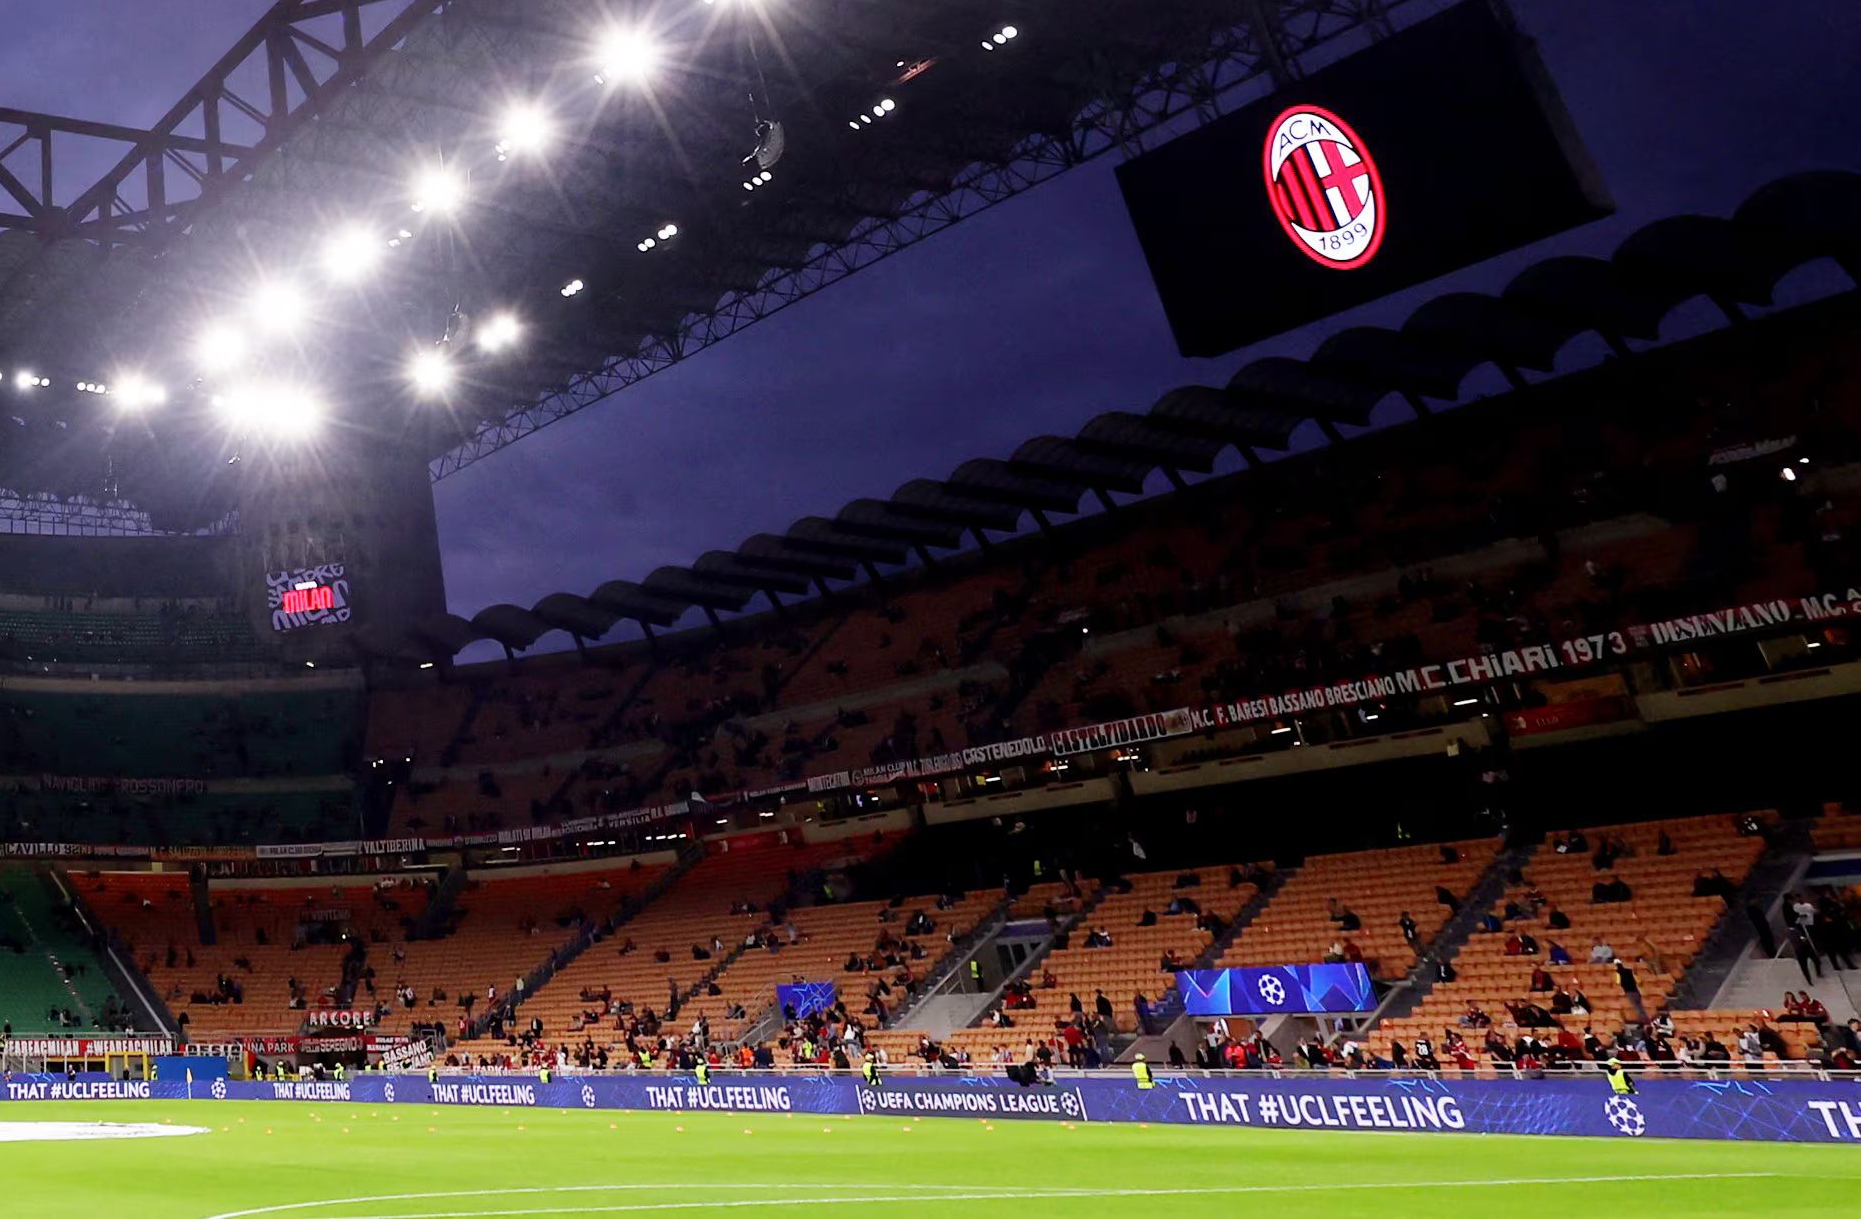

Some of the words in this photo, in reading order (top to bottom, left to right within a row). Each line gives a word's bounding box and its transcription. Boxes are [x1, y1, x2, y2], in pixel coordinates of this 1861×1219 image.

[1279, 120, 1331, 156] ACM
[1319, 223, 1368, 250] 1899
[283, 586, 333, 613] MILAN
[1650, 600, 1790, 645] DESENZANO
[1229, 699, 1268, 723] BARESI
[1269, 688, 1325, 716] BASSANO
[1326, 676, 1395, 708] BRESCIANO
[1052, 714, 1167, 756] CASTELFIDARDO
[310, 1011, 371, 1026] ARCORE
[268, 1042, 295, 1053] PARK
[383, 1040, 427, 1064] BASSANO
[7, 1083, 48, 1100] THAT
[50, 1081, 150, 1100] #UCLFEELING
[273, 1082, 295, 1099] THAT
[295, 1082, 351, 1101] #UCLFEELING
[431, 1084, 459, 1102] THAT
[461, 1084, 536, 1105] #UCLFEELING
[646, 1086, 683, 1108] THAT
[687, 1086, 791, 1110] #UCLFEELING
[876, 1091, 914, 1110] UEFA
[915, 1092, 997, 1111] CHAMPIONS
[1000, 1093, 1060, 1113] LEAGUE
[1179, 1092, 1249, 1123] THAT
[1258, 1093, 1465, 1130] #UCLFEELING
